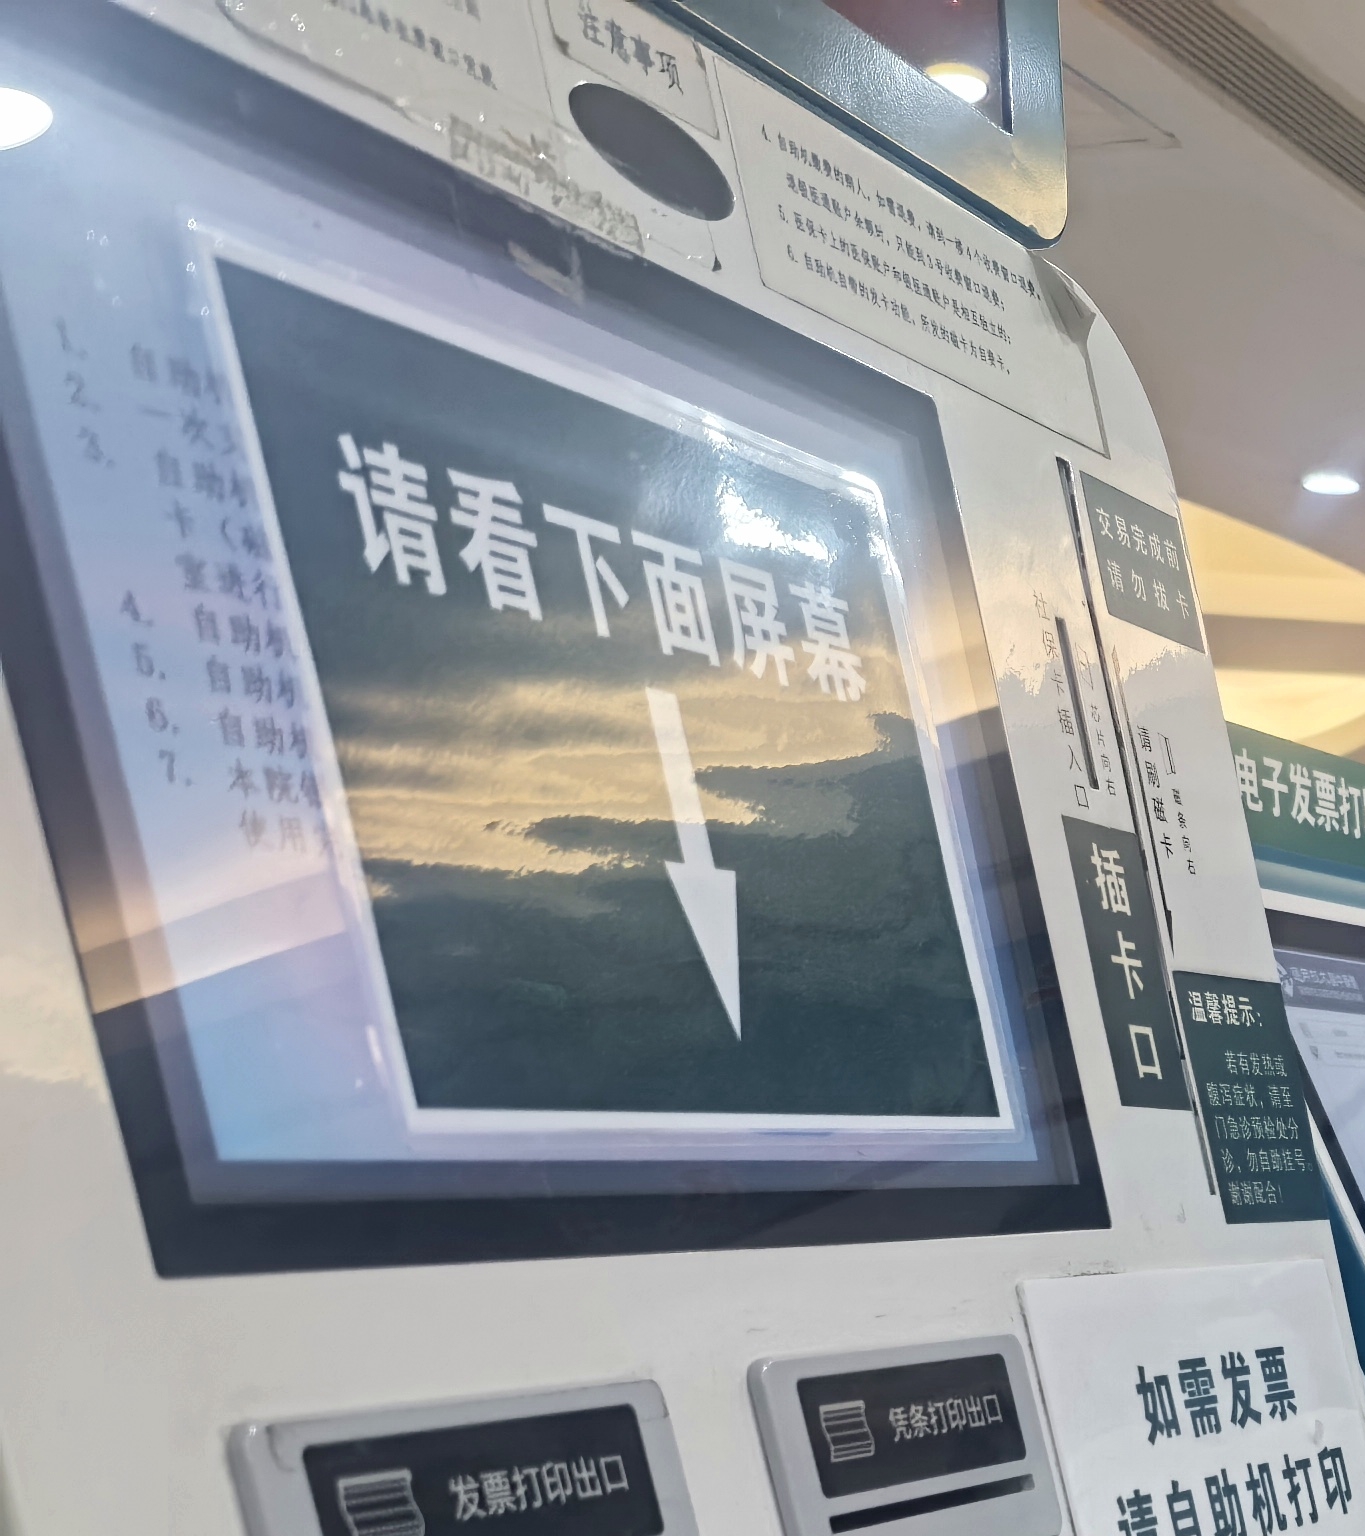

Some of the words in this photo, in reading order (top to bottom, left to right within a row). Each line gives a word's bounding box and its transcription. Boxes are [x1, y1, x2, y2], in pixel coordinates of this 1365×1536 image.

[337, 432, 867, 701] 请看下面屏幕
[1096, 507, 1180, 571] 交易完成前
[1107, 559, 1190, 620] 请勿拔卡
[1033, 590, 1090, 810] 社保卡插入口
[1091, 843, 1163, 1081] 插卡口
[1224, 1050, 1288, 1077] 若有发热或
[1214, 1115, 1299, 1140] 门急诊预检处分
[887, 1393, 1004, 1443] 凭条打印出口
[1135, 1345, 1298, 1446] 如需发票
[449, 1454, 630, 1521] 发票打印出口
